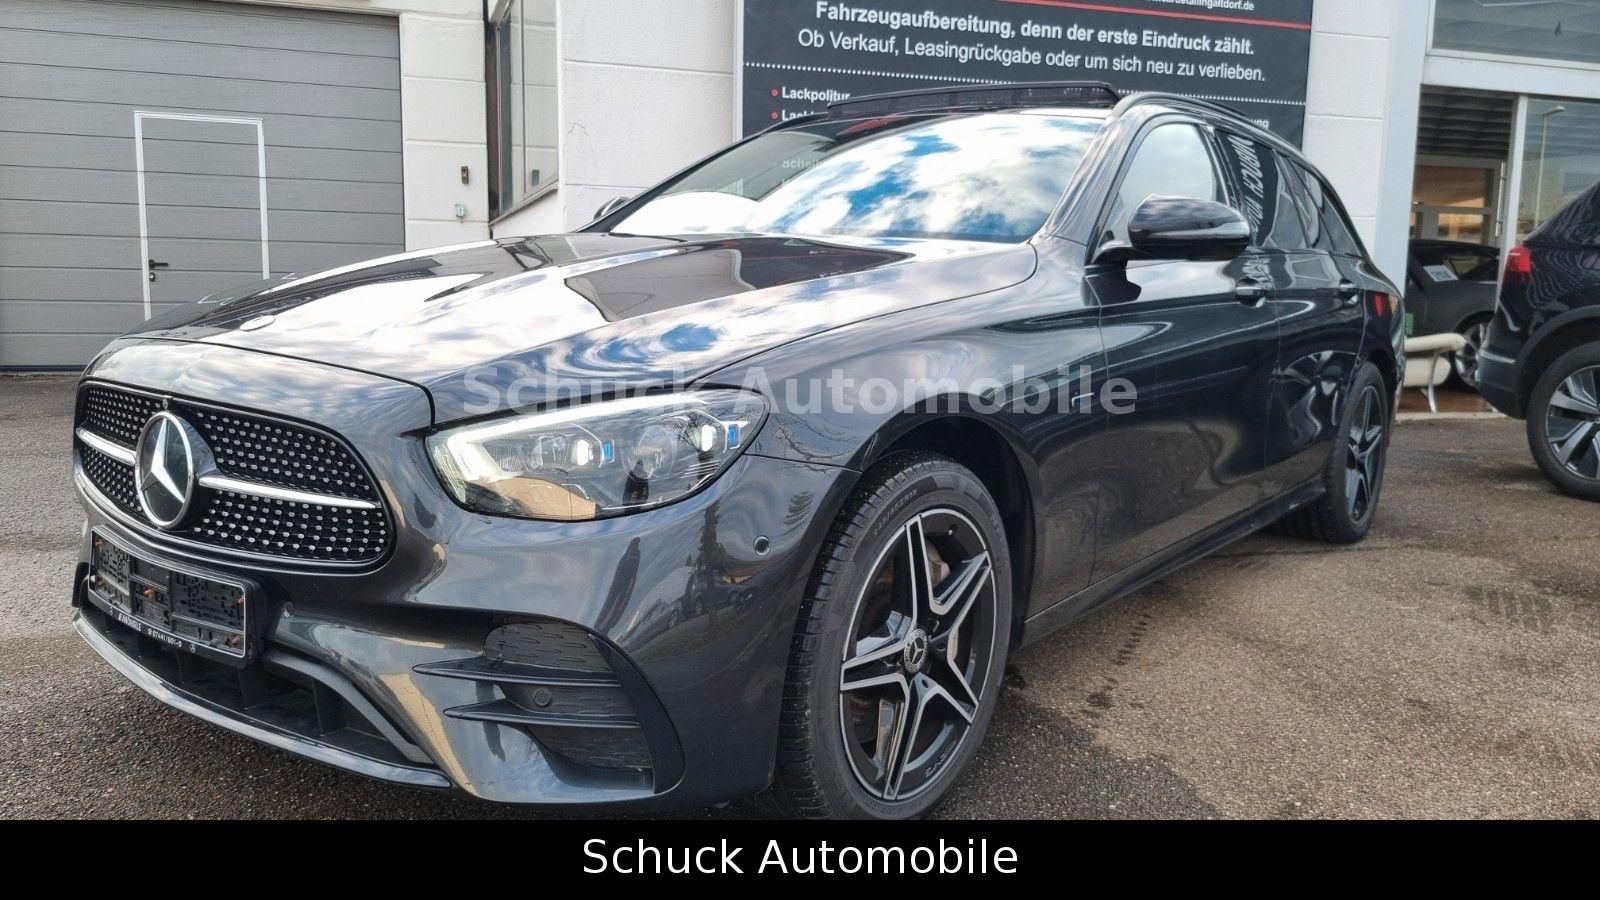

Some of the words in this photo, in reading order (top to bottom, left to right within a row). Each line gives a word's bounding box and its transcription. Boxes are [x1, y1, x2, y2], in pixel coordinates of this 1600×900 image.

[798, 28, 825, 48] Ob
[829, 31, 899, 56] Verkauf,
[905, 37, 1041, 67] Leasingrückgabe
[1045, 50, 1080, 68] oder
[1084, 56, 1109, 70] um
[1112, 55, 1142, 73] sich
[1146, 60, 1174, 75] neu
[1177, 63, 1195, 76] zu
[1198, 63, 1266, 82] verlieben.
[816, 1, 1016, 38] Fahrzeugaufbereitung,
[1021, 20, 1062, 40] denn
[1067, 24, 1093, 42] der
[1097, 29, 1138, 46] erste
[1142, 30, 1211, 52] Eindruck
[1214, 36, 1255, 55] zählt.
